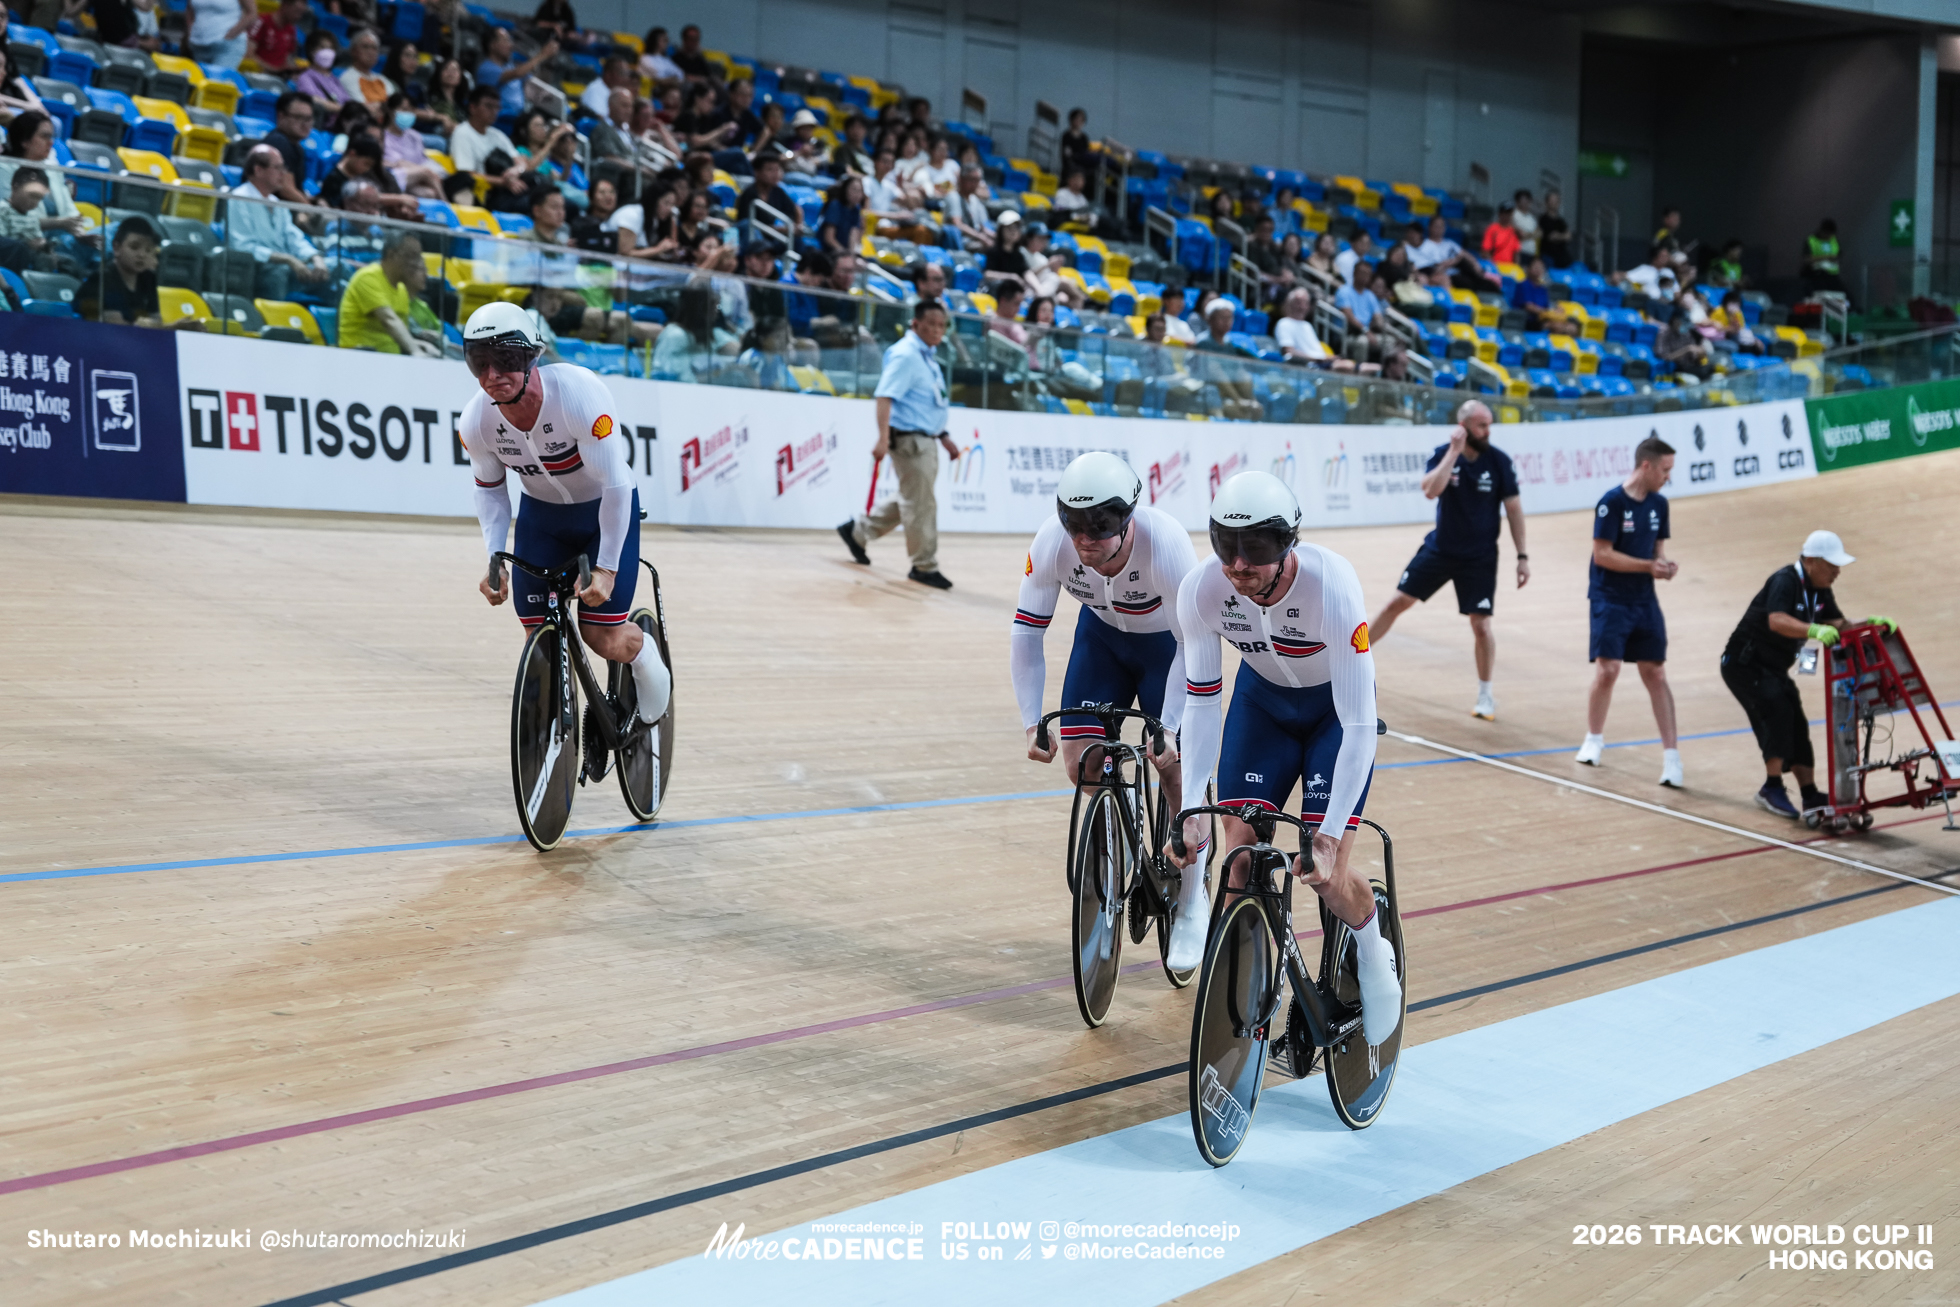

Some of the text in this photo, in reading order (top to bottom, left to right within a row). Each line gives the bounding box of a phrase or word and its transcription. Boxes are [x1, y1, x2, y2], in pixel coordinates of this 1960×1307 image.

[472, 326, 496, 334] LAZER
[0, 385, 35, 420] Hong
[35, 389, 71, 424] Kong
[19, 421, 52, 450] Club
[264, 394, 439, 462] TISSOT
[1068, 576, 1091, 589] LLOYDS
[1221, 611, 1247, 620] LLOYDS
[562, 636, 570, 714] LOTUS
[1303, 791, 1332, 800] LOYDS
